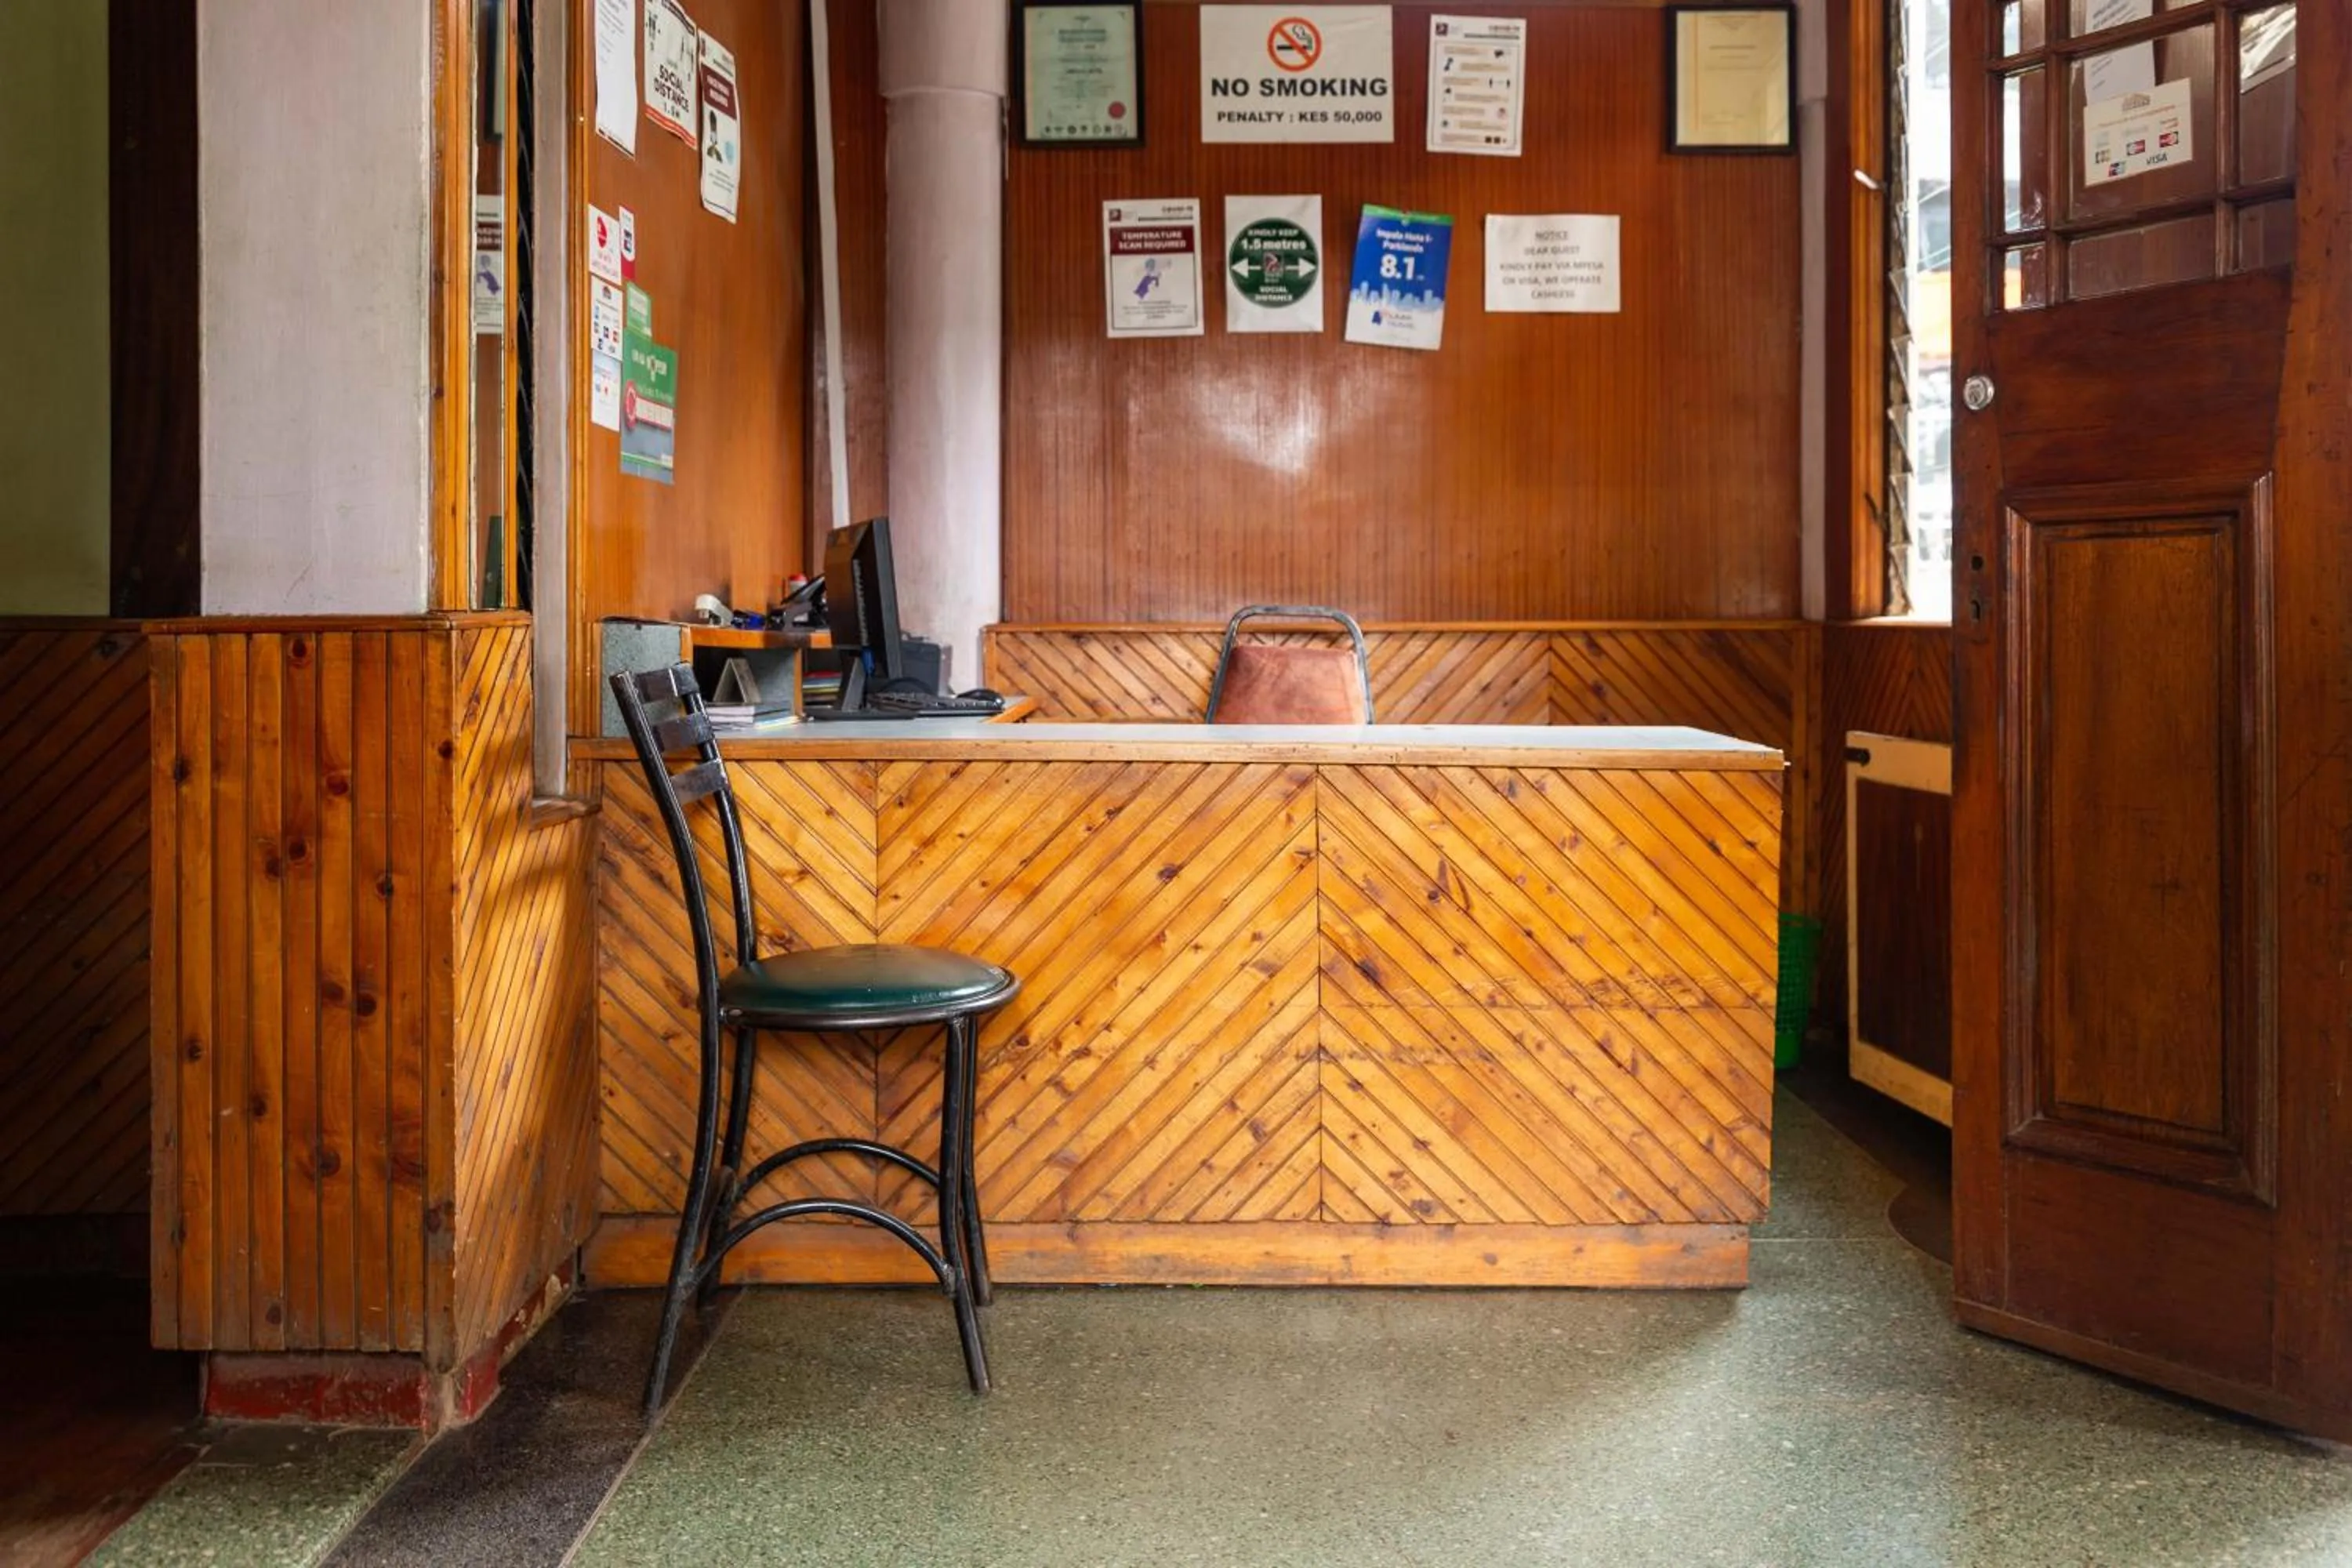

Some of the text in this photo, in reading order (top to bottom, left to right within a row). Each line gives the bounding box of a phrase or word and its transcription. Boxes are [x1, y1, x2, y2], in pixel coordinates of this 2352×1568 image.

[659, 64, 684, 94] SOCIAL
[1211, 78, 1388, 97] NO SMOKING
[654, 77, 689, 113] DISTANCE
[1218, 111, 1284, 122] PENALTY
[1298, 111, 1329, 122] KES
[1334, 111, 1382, 124] 50,000
[2146, 153, 2168, 165] VISA
[1122, 230, 1182, 240] TEMPERATURE
[1119, 240, 1186, 249] SCAN REQUIRED
[1241, 238, 1307, 250] 1.5 metres
[1380, 254, 1415, 280] 8.1
